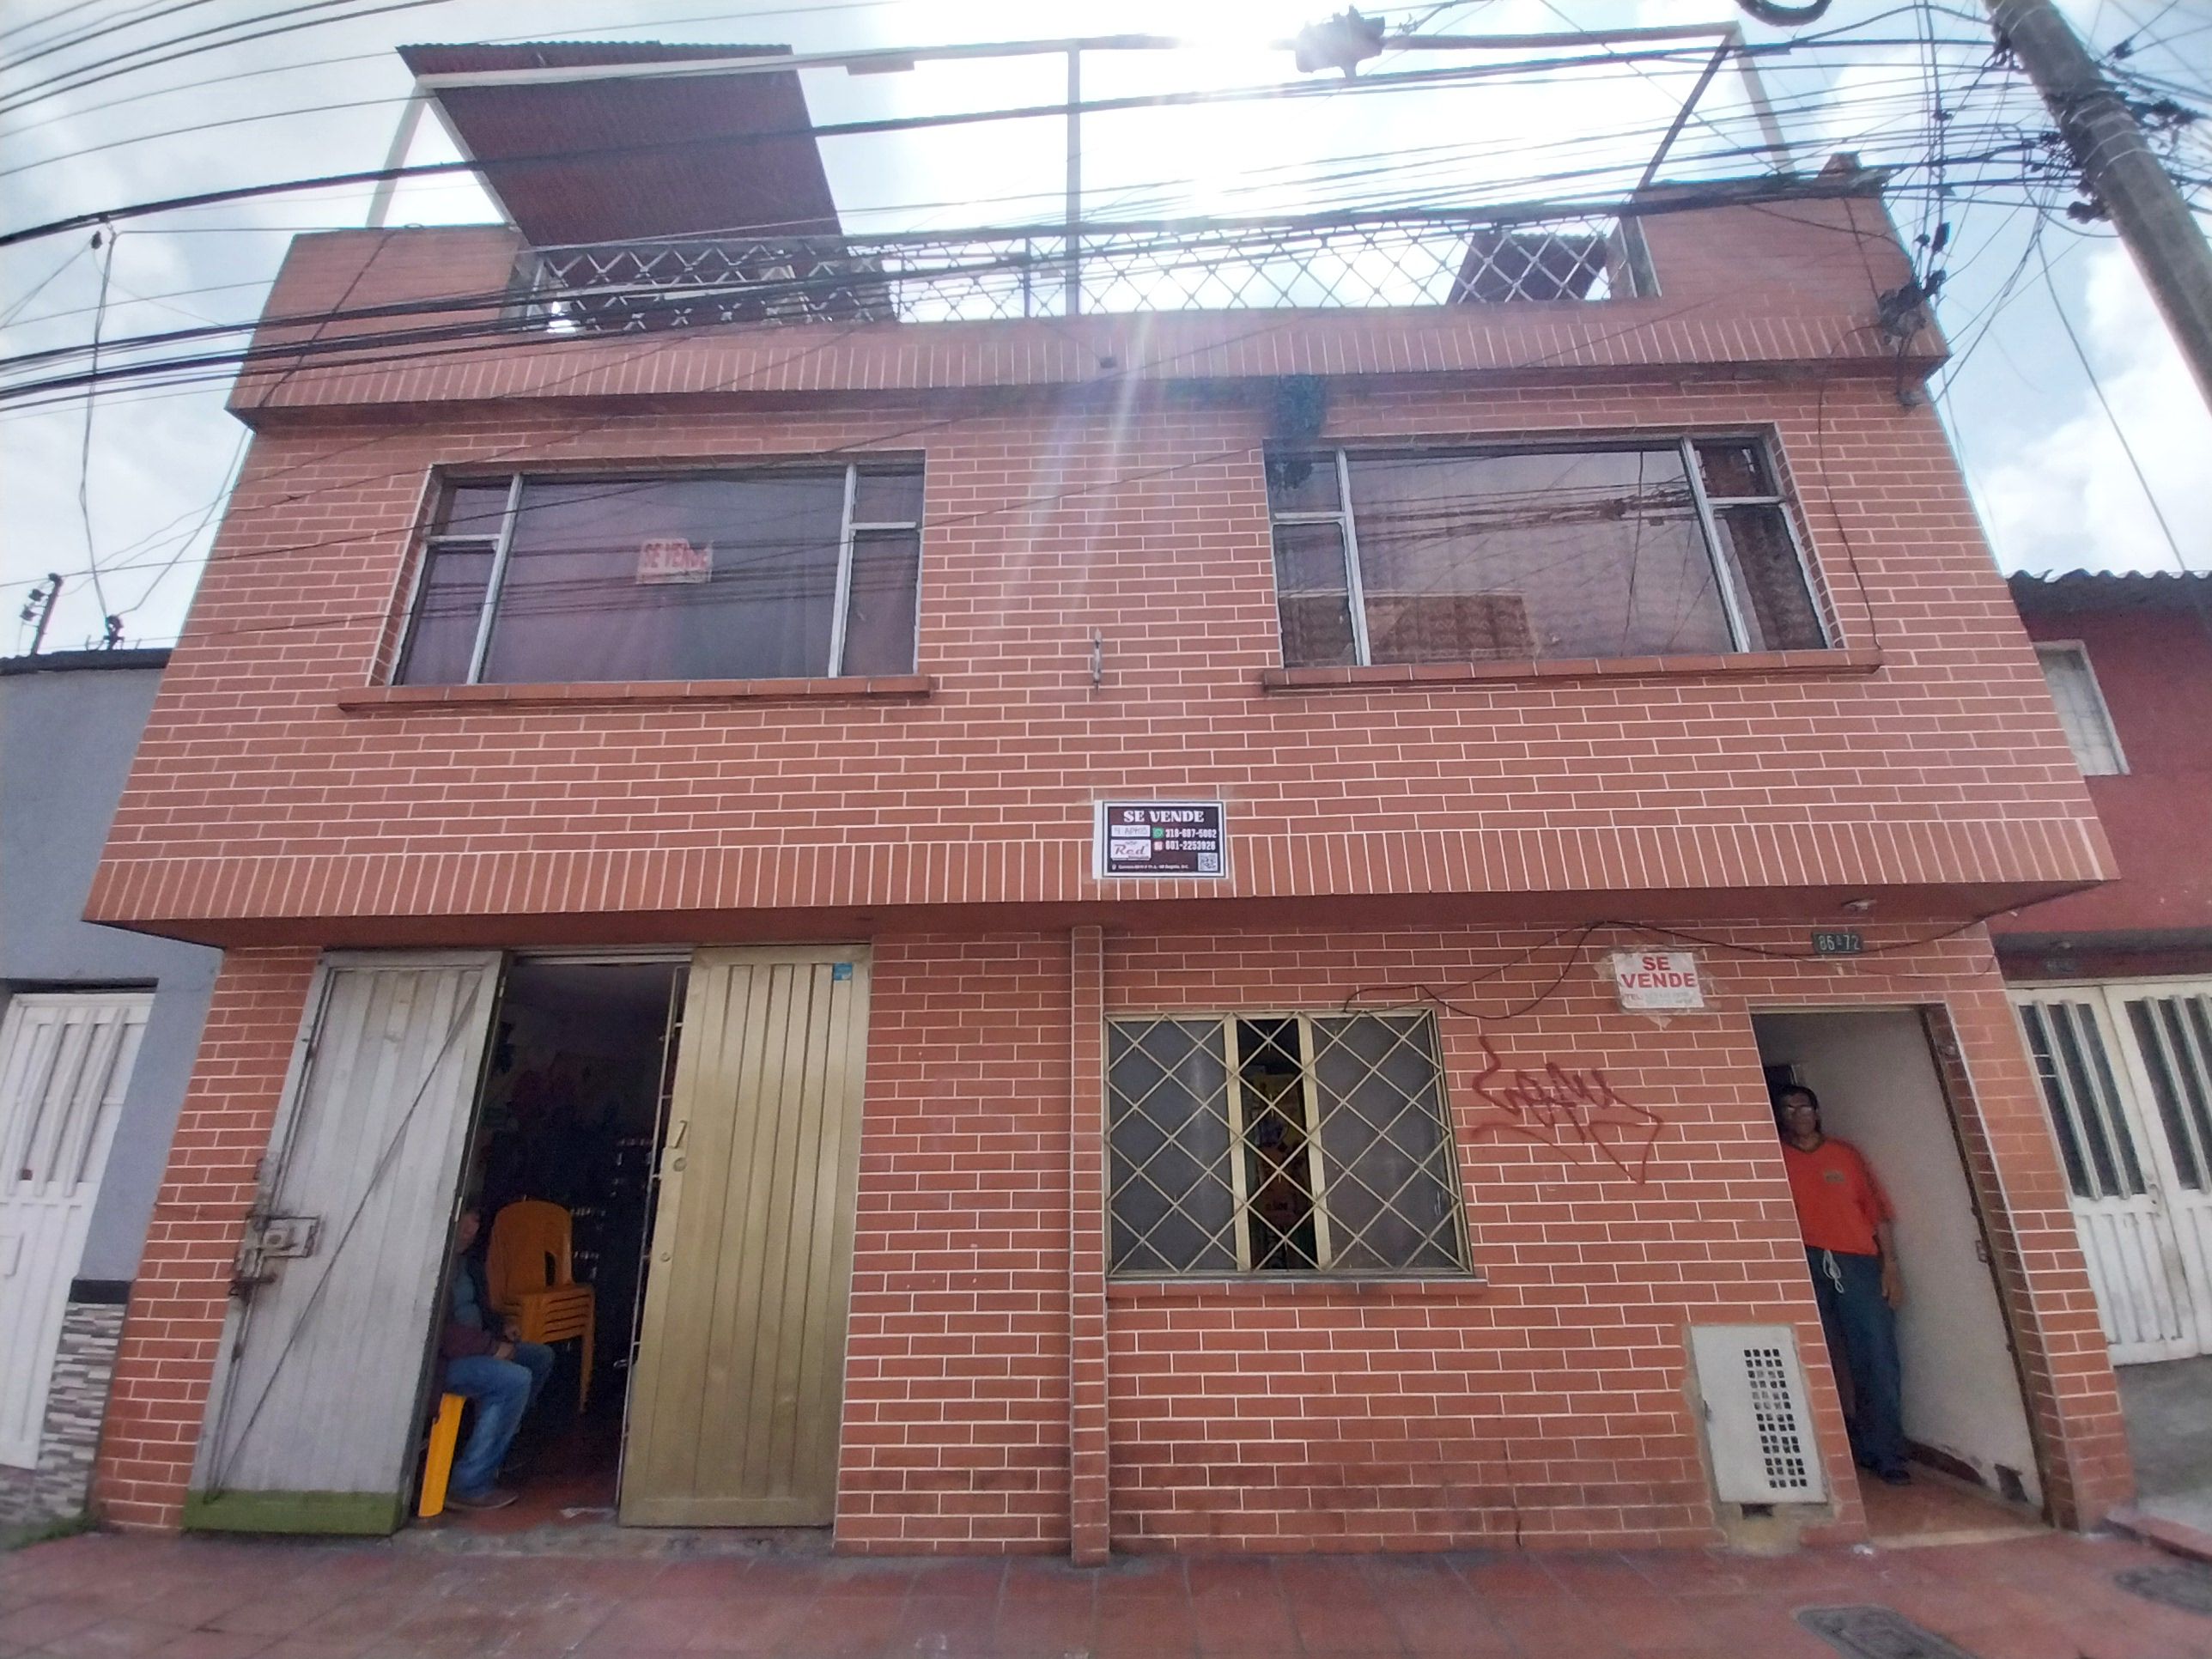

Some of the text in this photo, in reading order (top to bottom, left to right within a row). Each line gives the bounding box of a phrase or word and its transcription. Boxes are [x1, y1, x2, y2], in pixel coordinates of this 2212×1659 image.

[1123, 810, 1205, 823] SE VENDE
[1642, 956, 1671, 971] SE
[1620, 972, 1698, 988] VENDE
